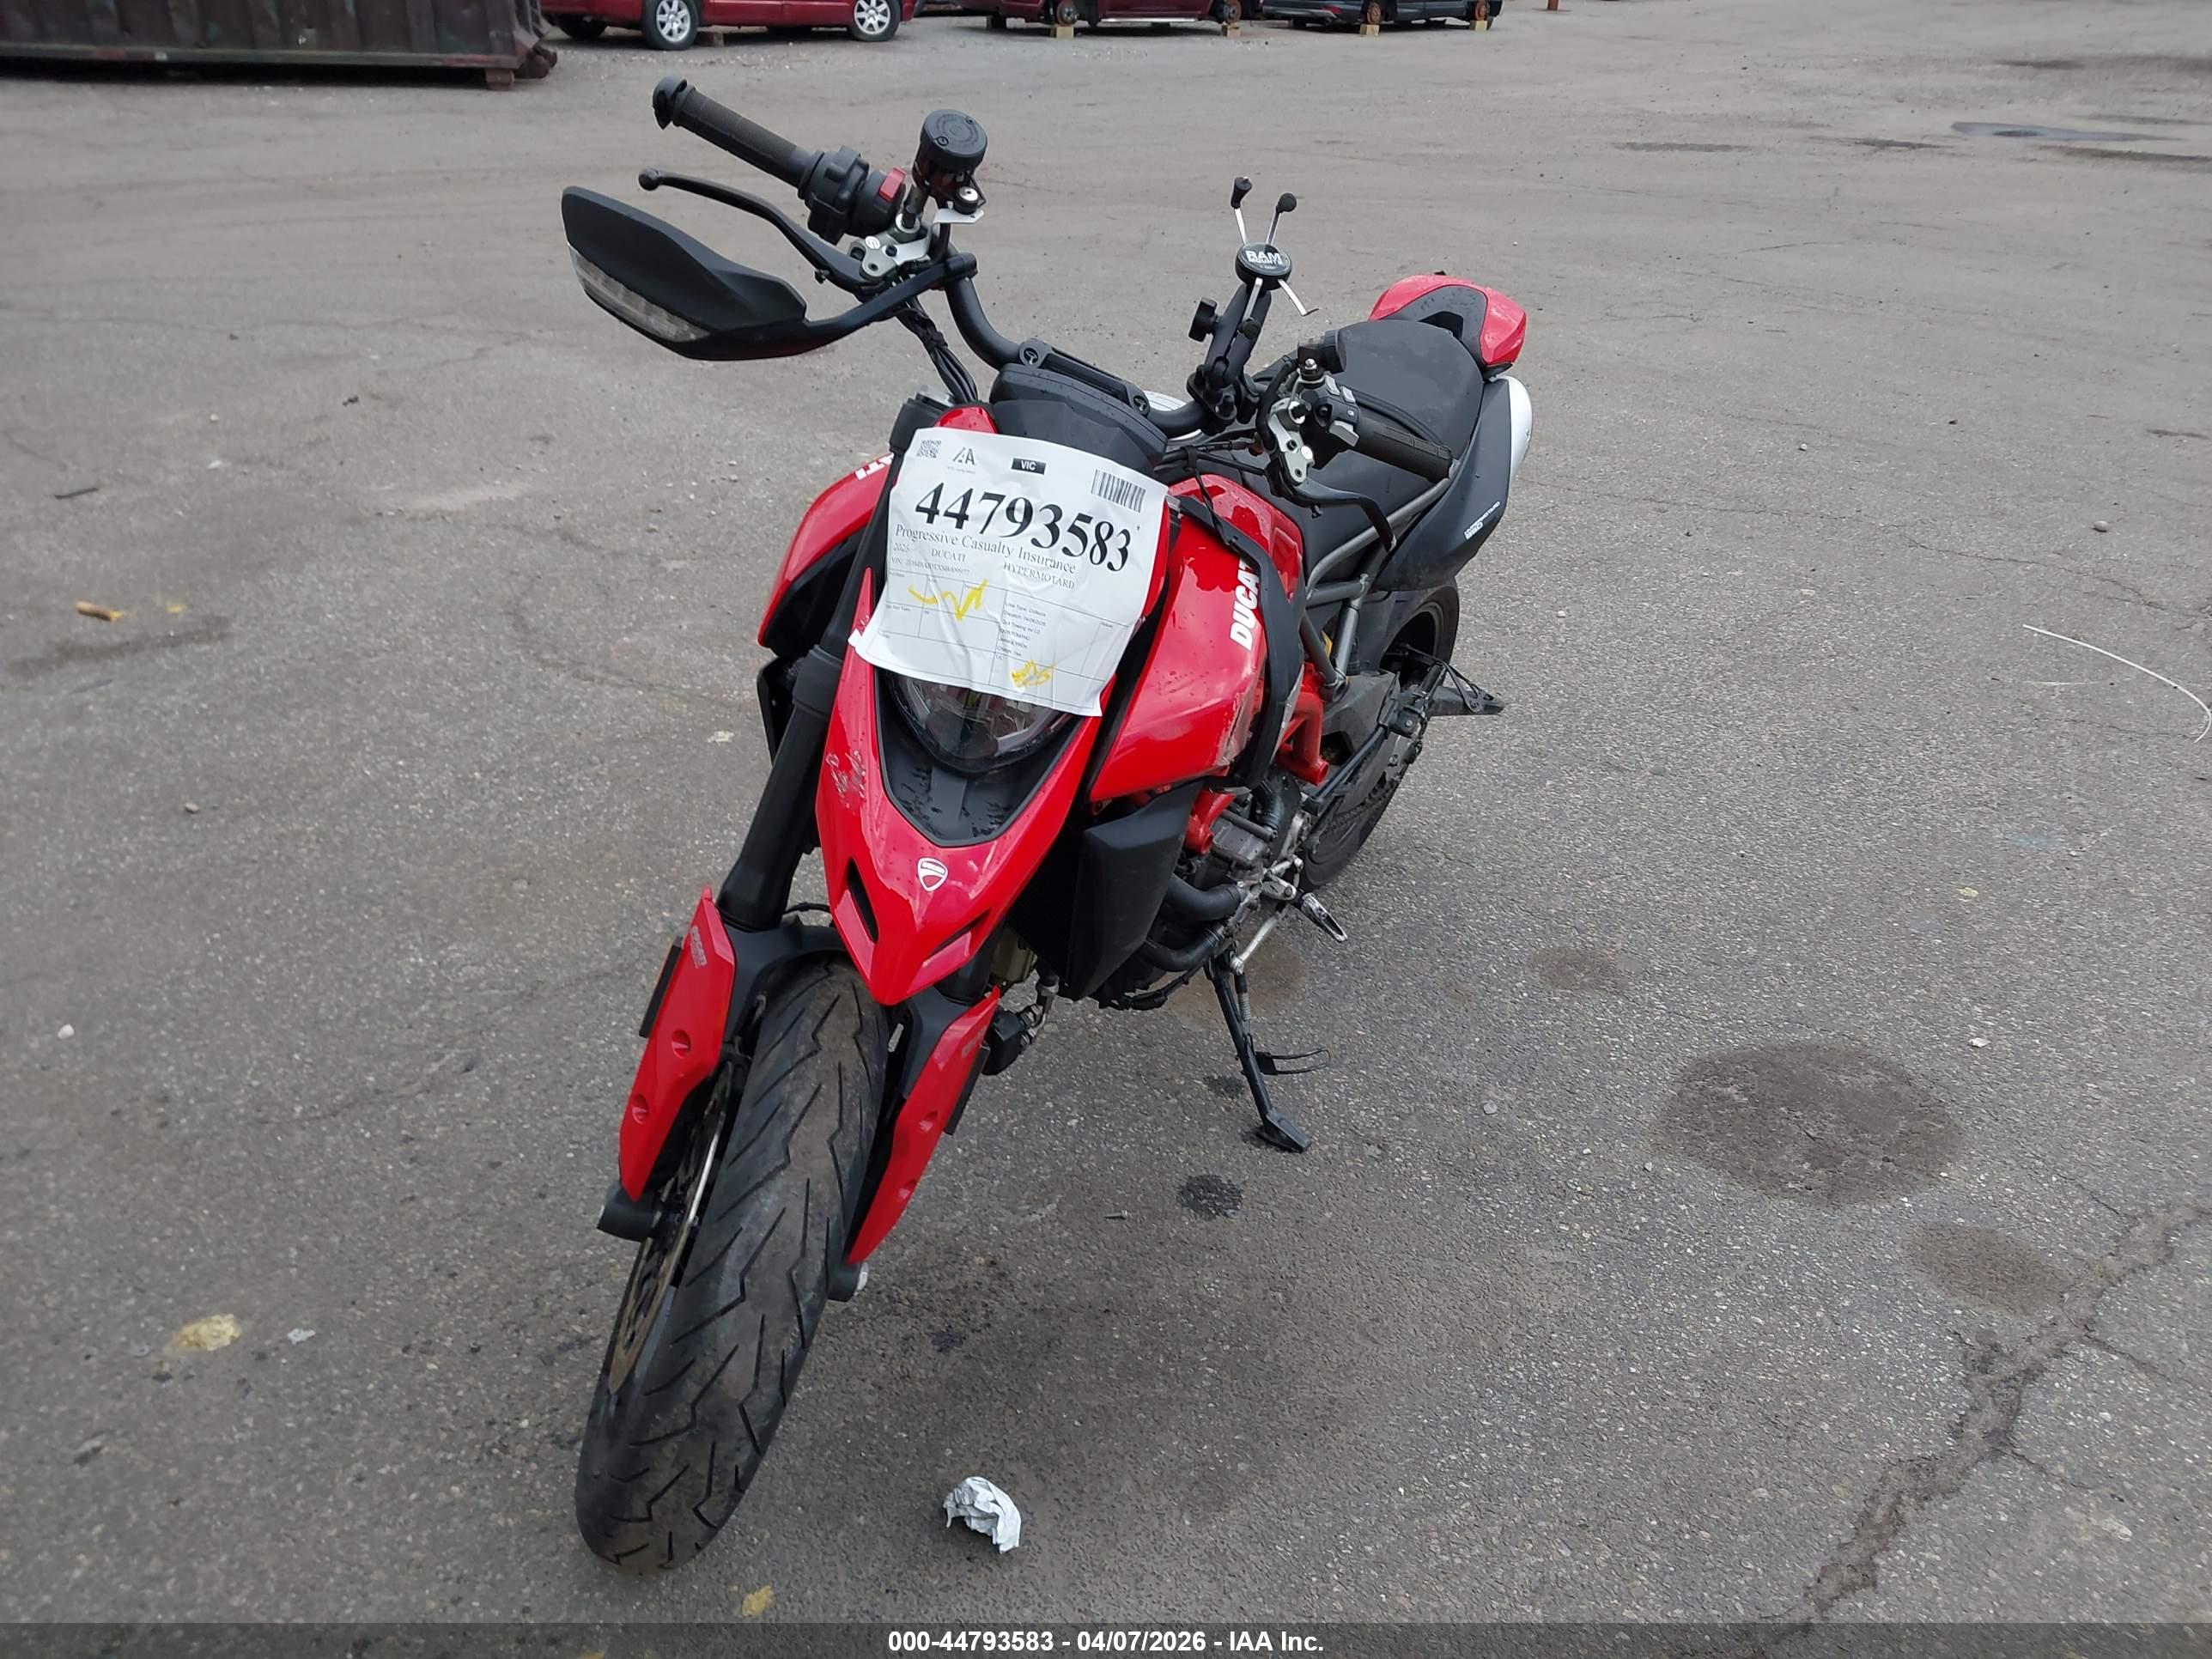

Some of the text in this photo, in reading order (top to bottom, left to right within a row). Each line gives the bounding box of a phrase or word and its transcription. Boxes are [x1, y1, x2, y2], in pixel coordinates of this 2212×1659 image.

[1020, 459, 1036, 471] VIC
[895, 523, 1076, 574] Progressive Casualty Insurance
[915, 482, 1132, 572] 44793583
[931, 548, 967, 562] DUCATI
[1003, 561, 1076, 589] HYPERMOTARD
